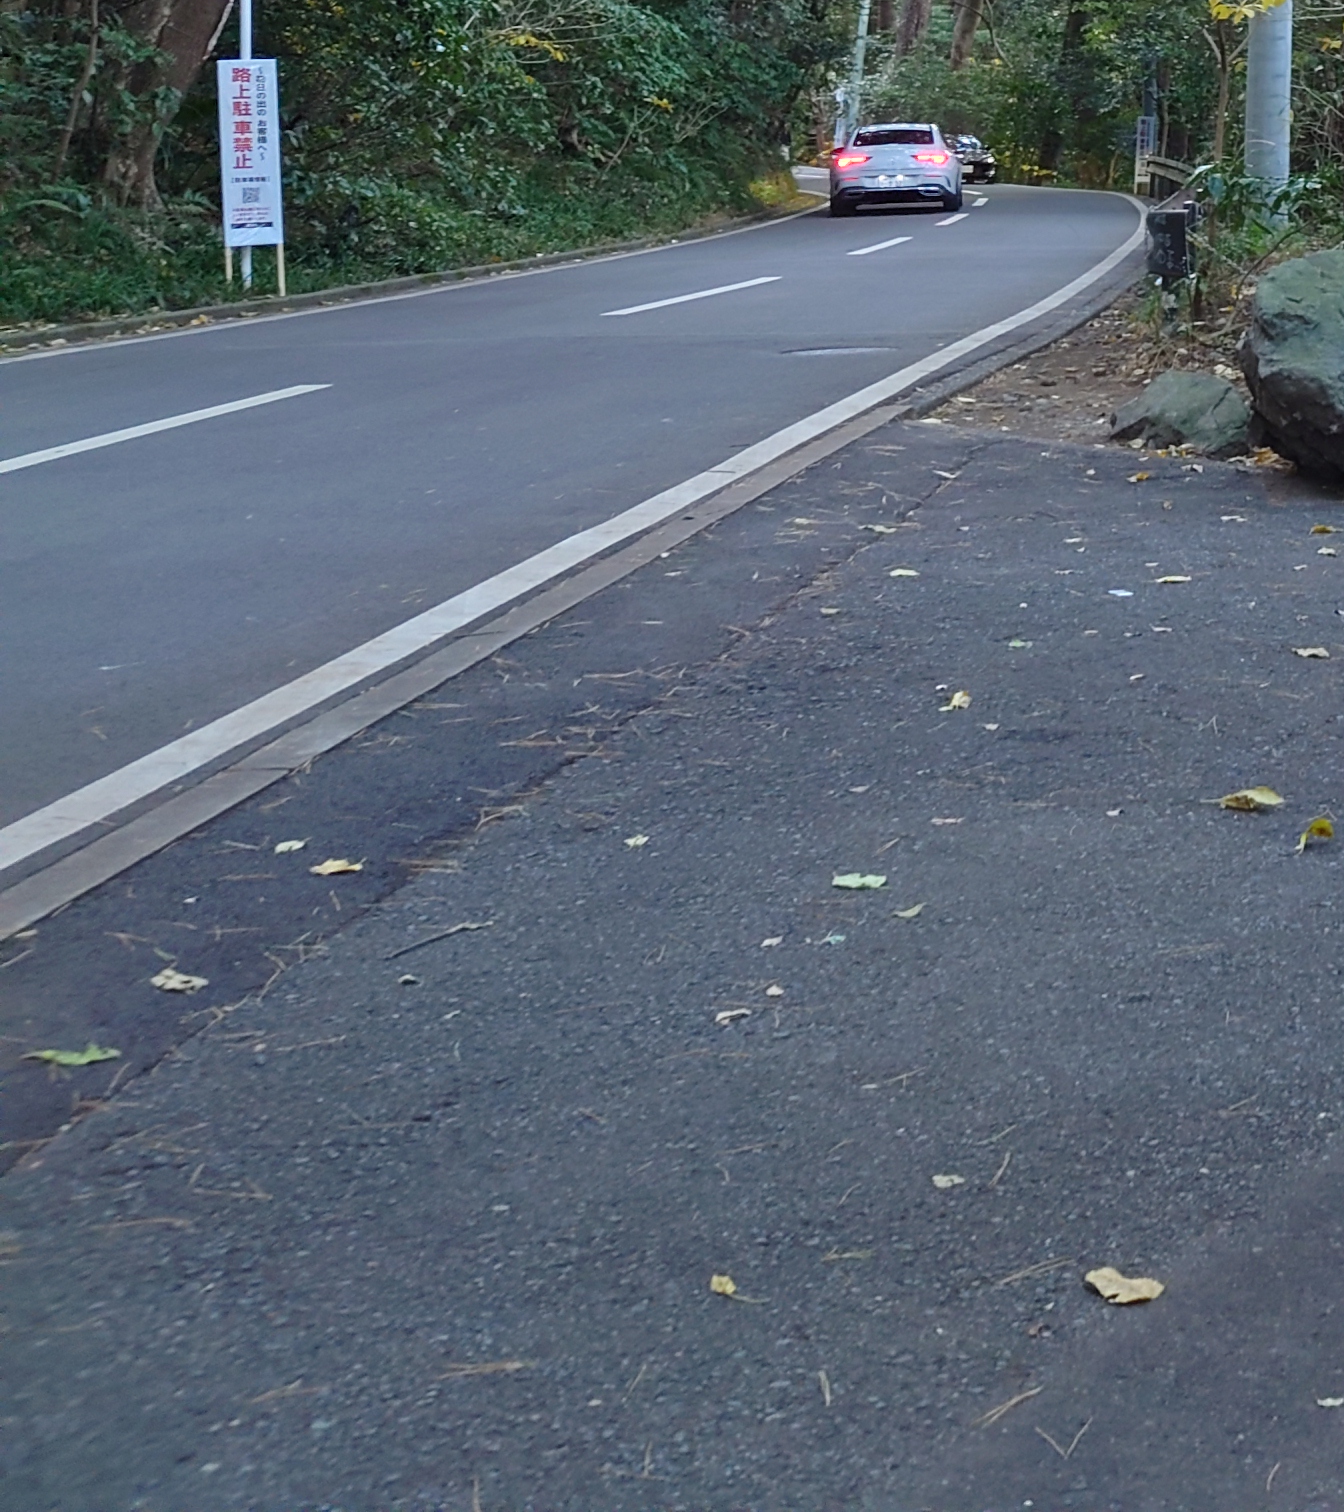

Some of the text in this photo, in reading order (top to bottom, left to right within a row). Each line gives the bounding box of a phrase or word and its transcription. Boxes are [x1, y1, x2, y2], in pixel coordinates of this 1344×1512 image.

[231, 67, 254, 170] 路上駐車禁止
